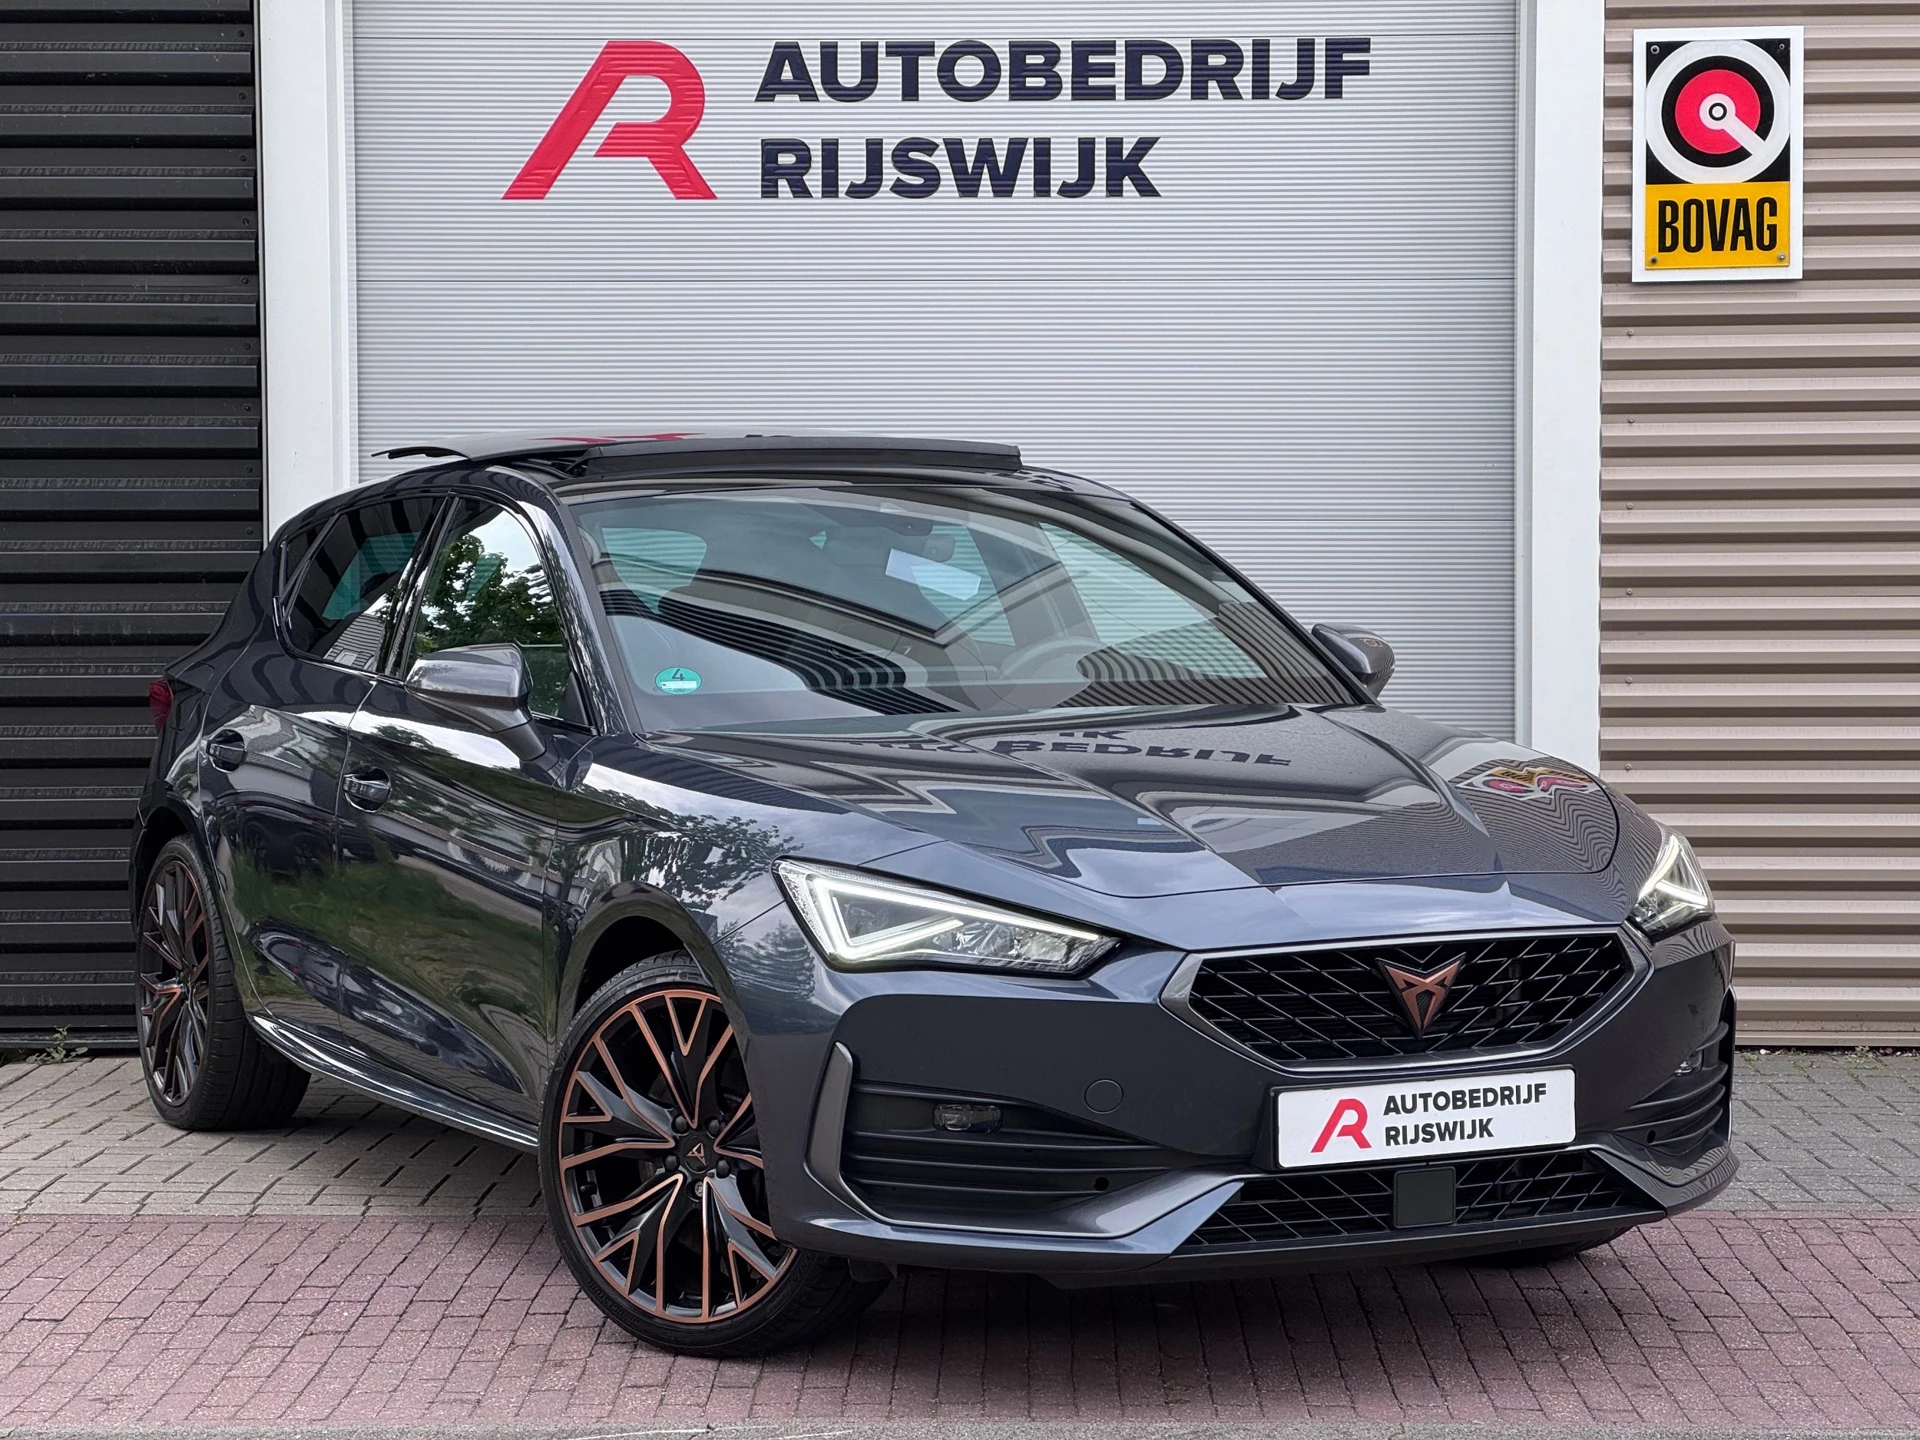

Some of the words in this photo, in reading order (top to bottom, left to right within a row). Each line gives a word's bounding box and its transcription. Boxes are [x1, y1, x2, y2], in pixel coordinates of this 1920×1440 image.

[754, 37, 1371, 102] AUTOBEDRIJF
[760, 136, 1162, 199] RIJSWIJK
[1657, 196, 1778, 253] BOVAG
[671, 668, 685, 681] 4
[1383, 1083, 1547, 1116] AUTOBEDRIJF
[1384, 1117, 1494, 1147] RIJSWIJK
